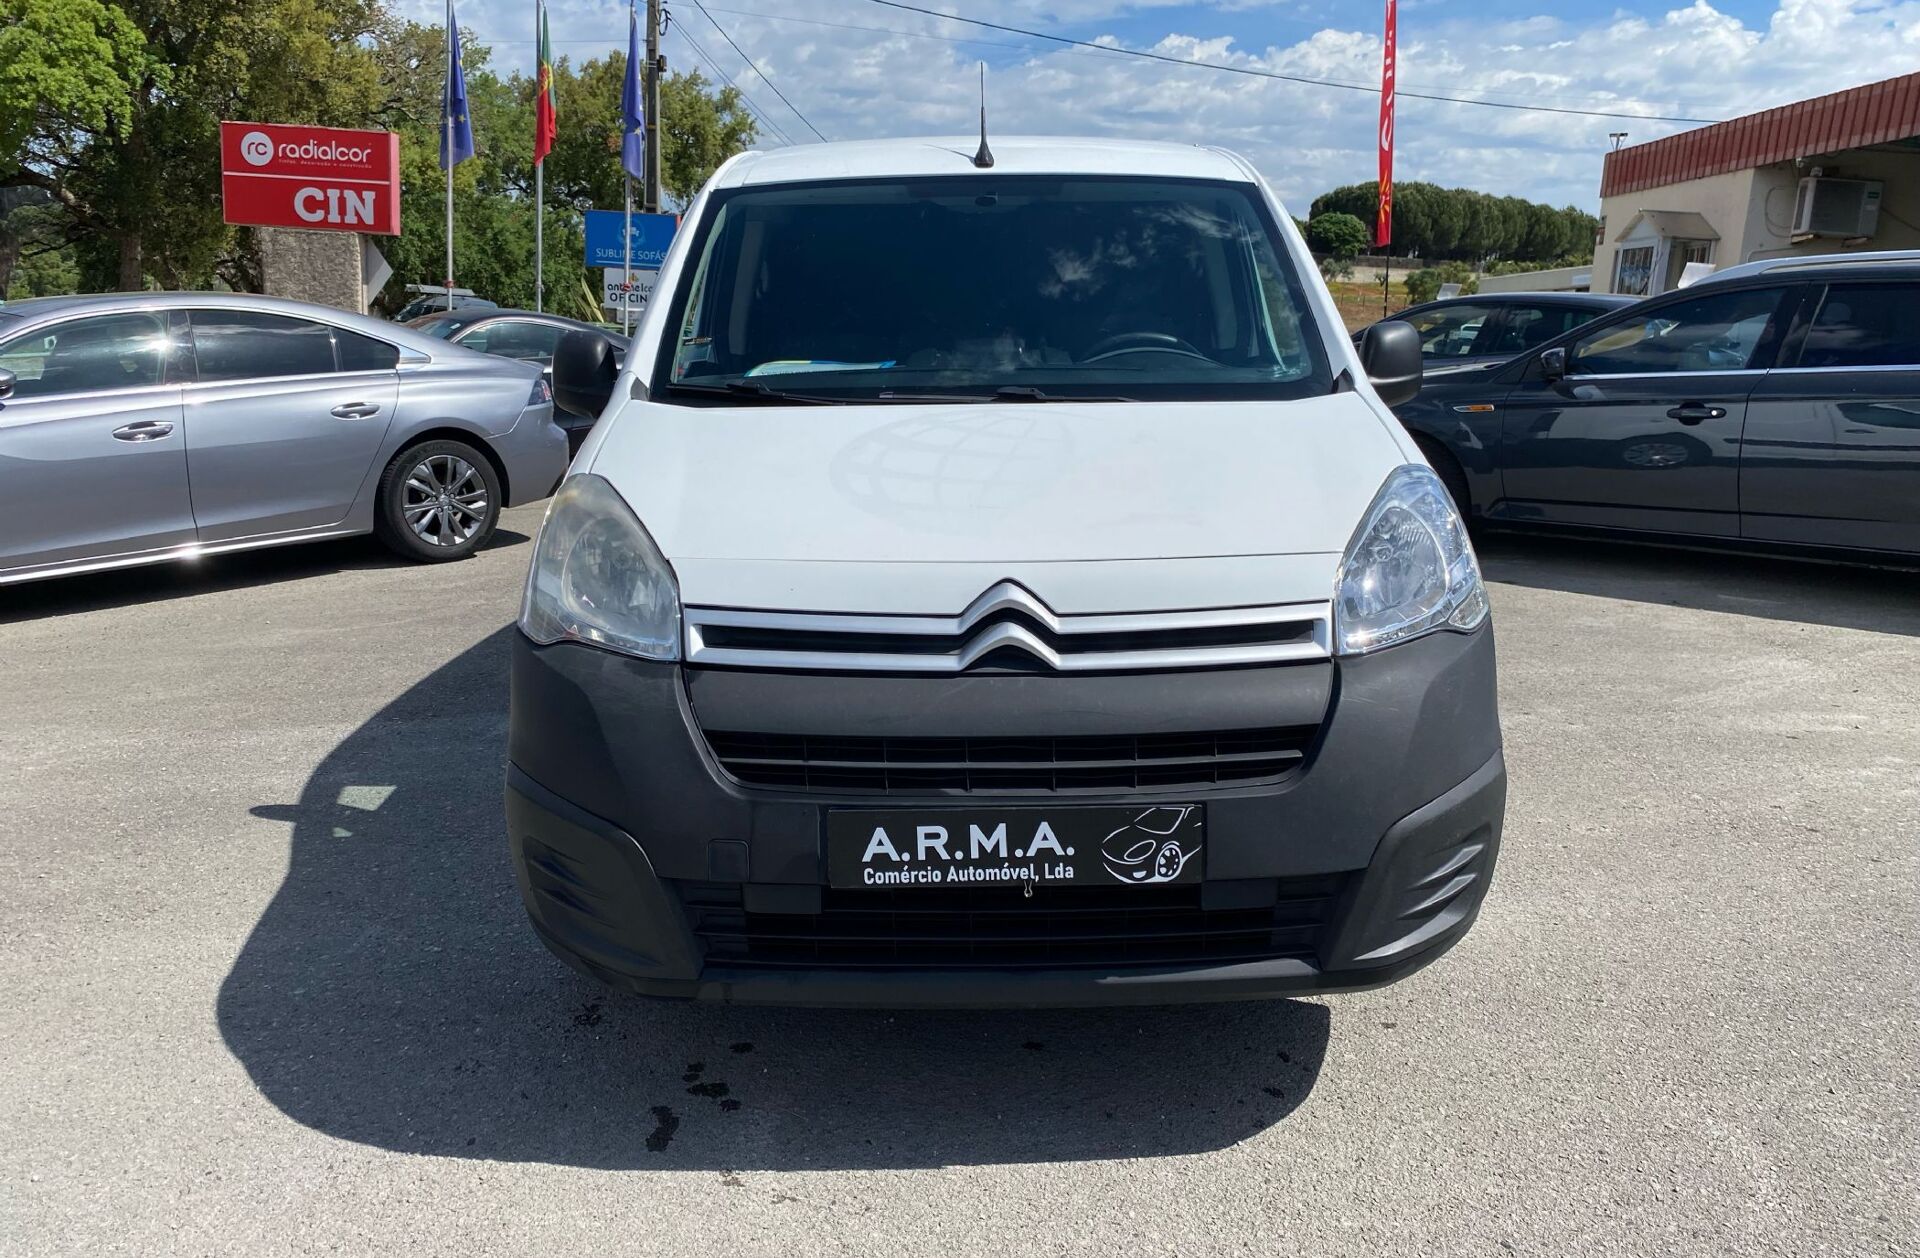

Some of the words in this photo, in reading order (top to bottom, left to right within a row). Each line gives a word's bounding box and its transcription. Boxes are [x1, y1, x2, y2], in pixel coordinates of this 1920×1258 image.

[247, 141, 268, 156] rc
[278, 138, 372, 163] radialcor
[293, 186, 376, 225] CIN
[861, 821, 1075, 863] A.R.M.A.
[863, 865, 941, 885] Comércio
[947, 863, 1040, 884] Automóvel,
[1044, 863, 1074, 880] Lda
